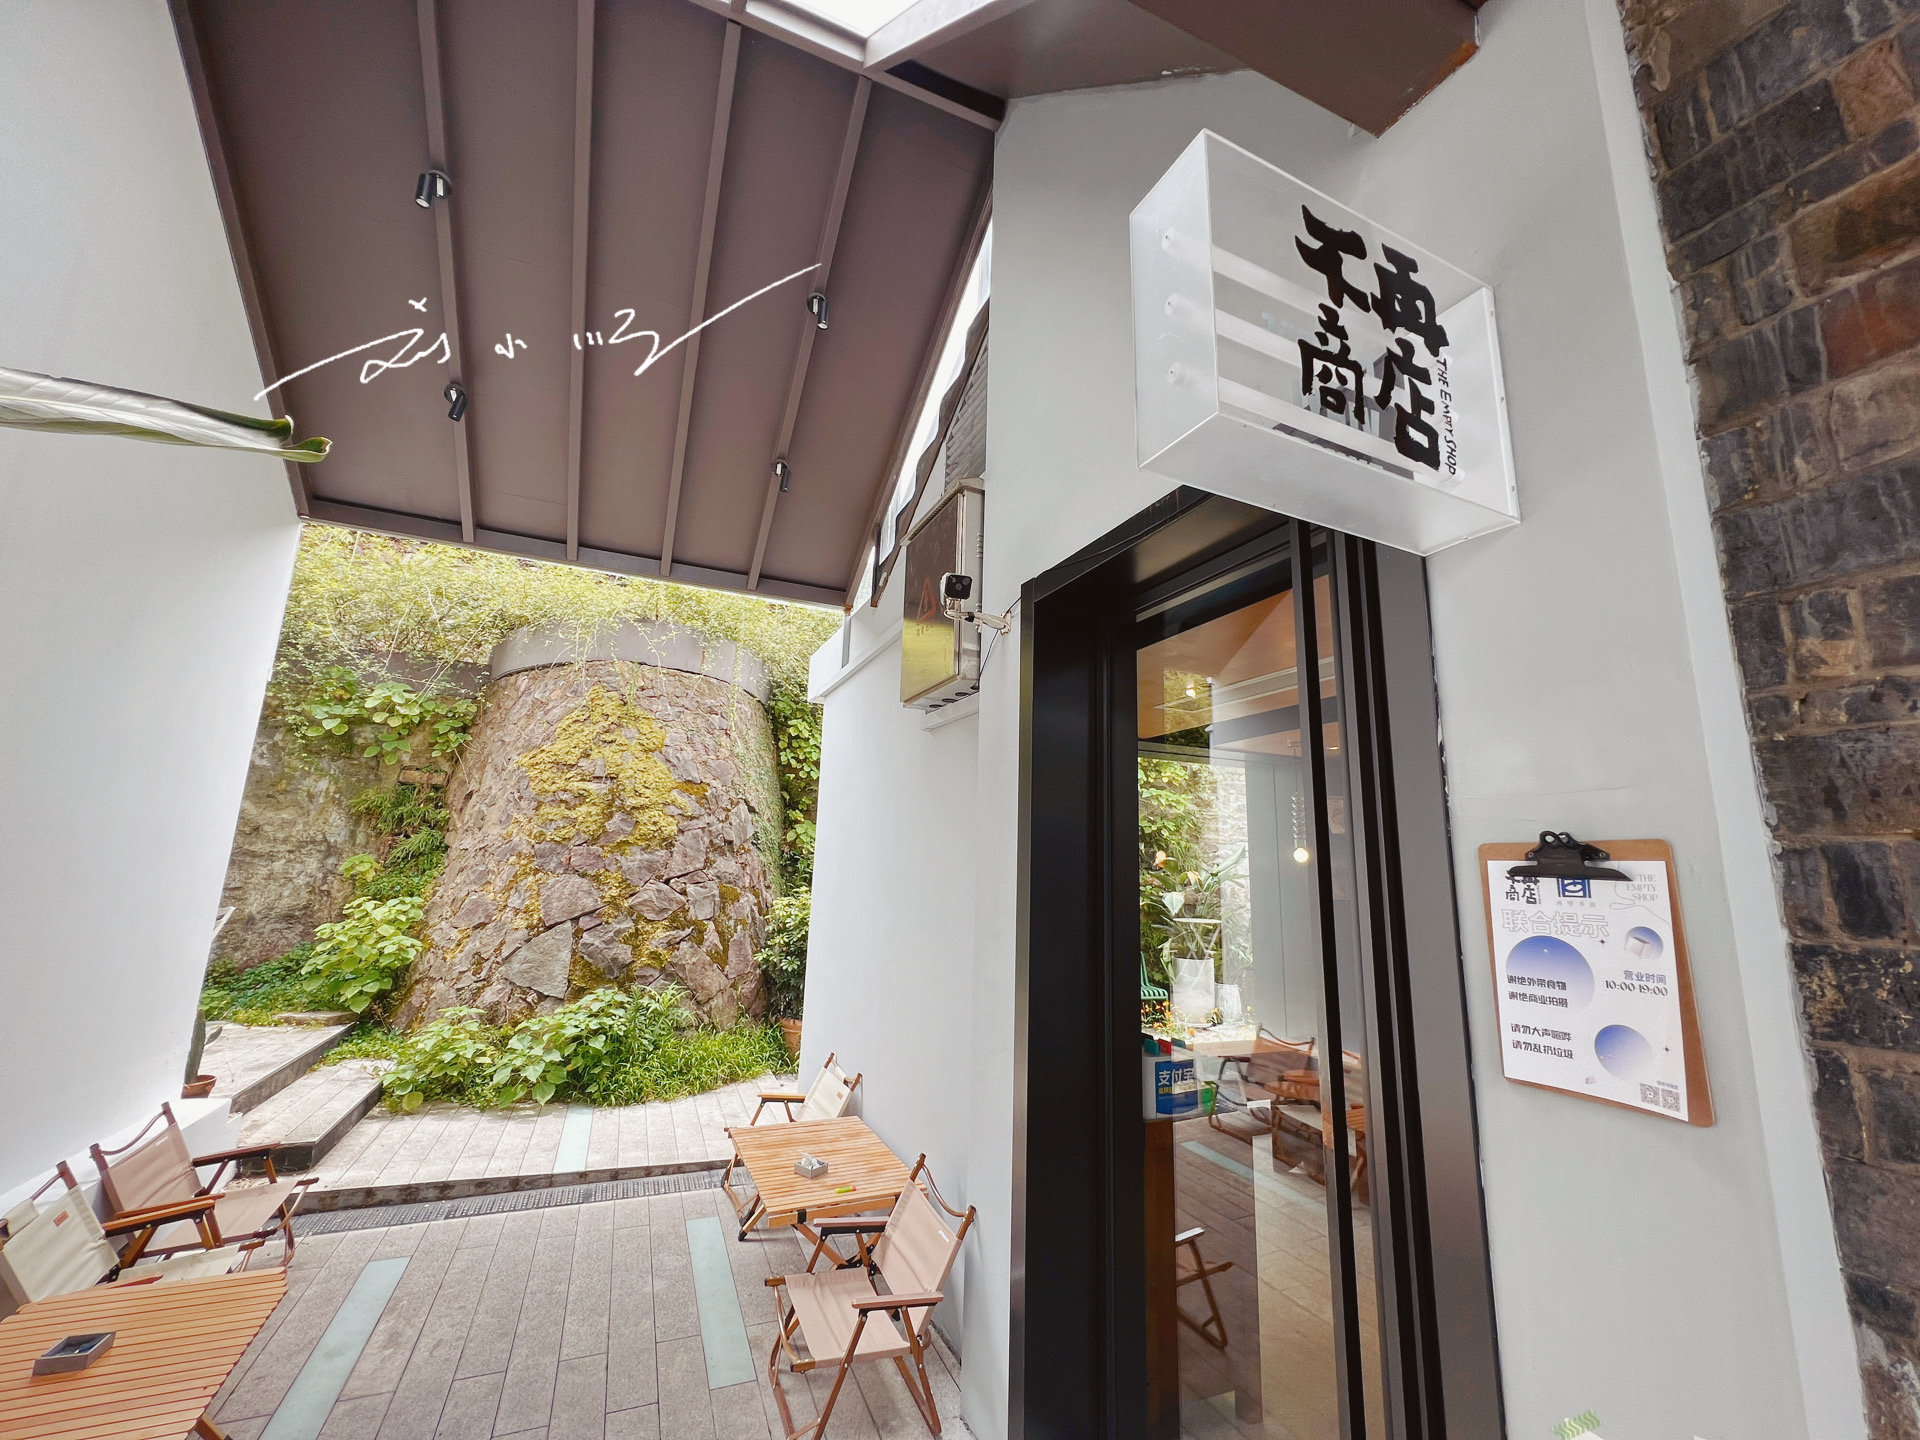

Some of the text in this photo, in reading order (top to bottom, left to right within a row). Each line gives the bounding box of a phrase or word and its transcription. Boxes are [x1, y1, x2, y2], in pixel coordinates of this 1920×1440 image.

[1297, 302, 1441, 472] 商店
[1436, 357, 1449, 388] THE
[1444, 435, 1457, 476] SHOP
[1638, 873, 1657, 883] THE
[1505, 884, 1538, 905] 商店
[1626, 883, 1657, 893] EMPTY
[1632, 893, 1659, 902] SHOP
[1500, 908, 1610, 939] 联合提示
[1506, 974, 1567, 991] 谢绝外带食物
[1623, 970, 1667, 985] 营业时间
[1605, 979, 1669, 997] 10:00-19:00
[1508, 990, 1569, 1009] 谢绝商业拍摄
[1511, 1022, 1572, 1042] 请勿大声喧哗
[1512, 1039, 1574, 1060] 请勿乱扔垃圾
[1158, 1067, 1194, 1086] 支付宝
